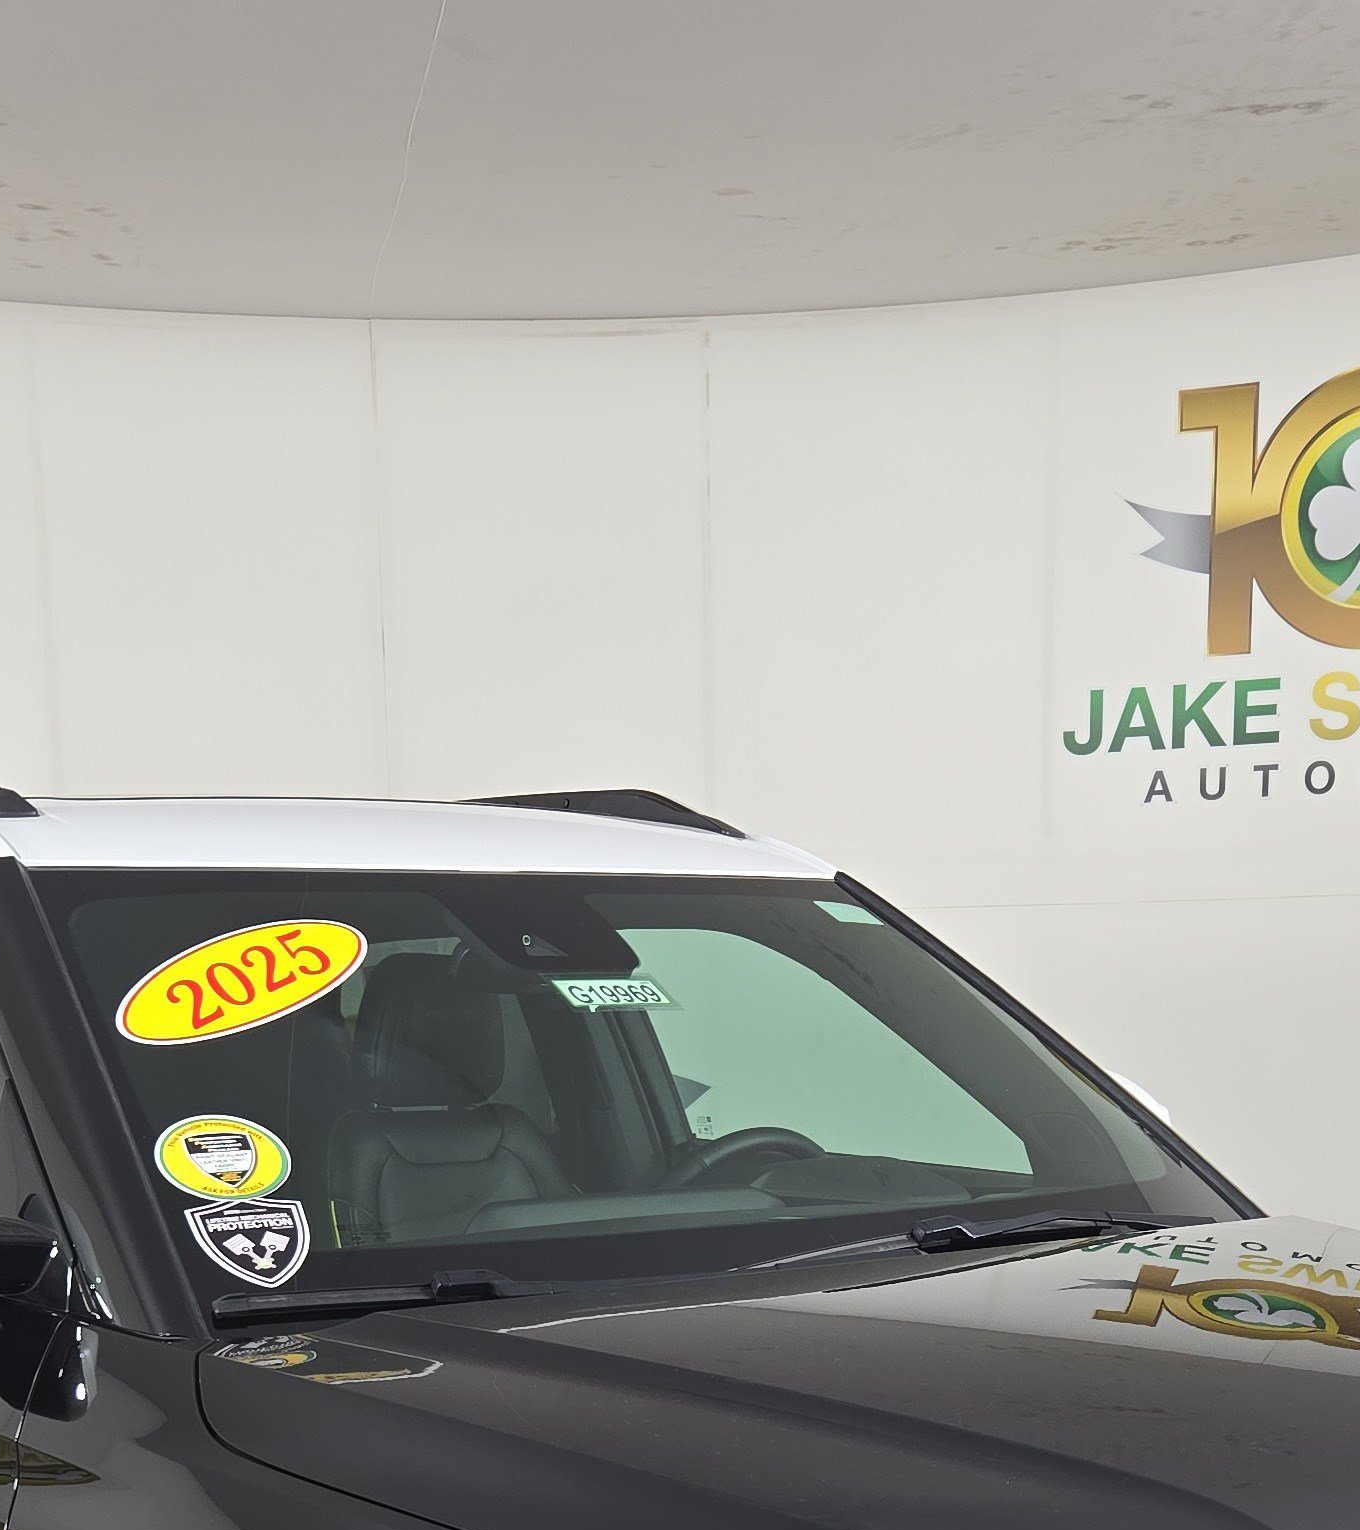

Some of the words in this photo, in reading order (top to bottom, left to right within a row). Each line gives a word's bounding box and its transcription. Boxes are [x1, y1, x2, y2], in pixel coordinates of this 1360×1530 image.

[1061, 677, 1282, 756] JAKE
[166, 929, 331, 1030] 2025
[567, 984, 662, 1004] G19969
[206, 1217, 295, 1233] PROTECTION
